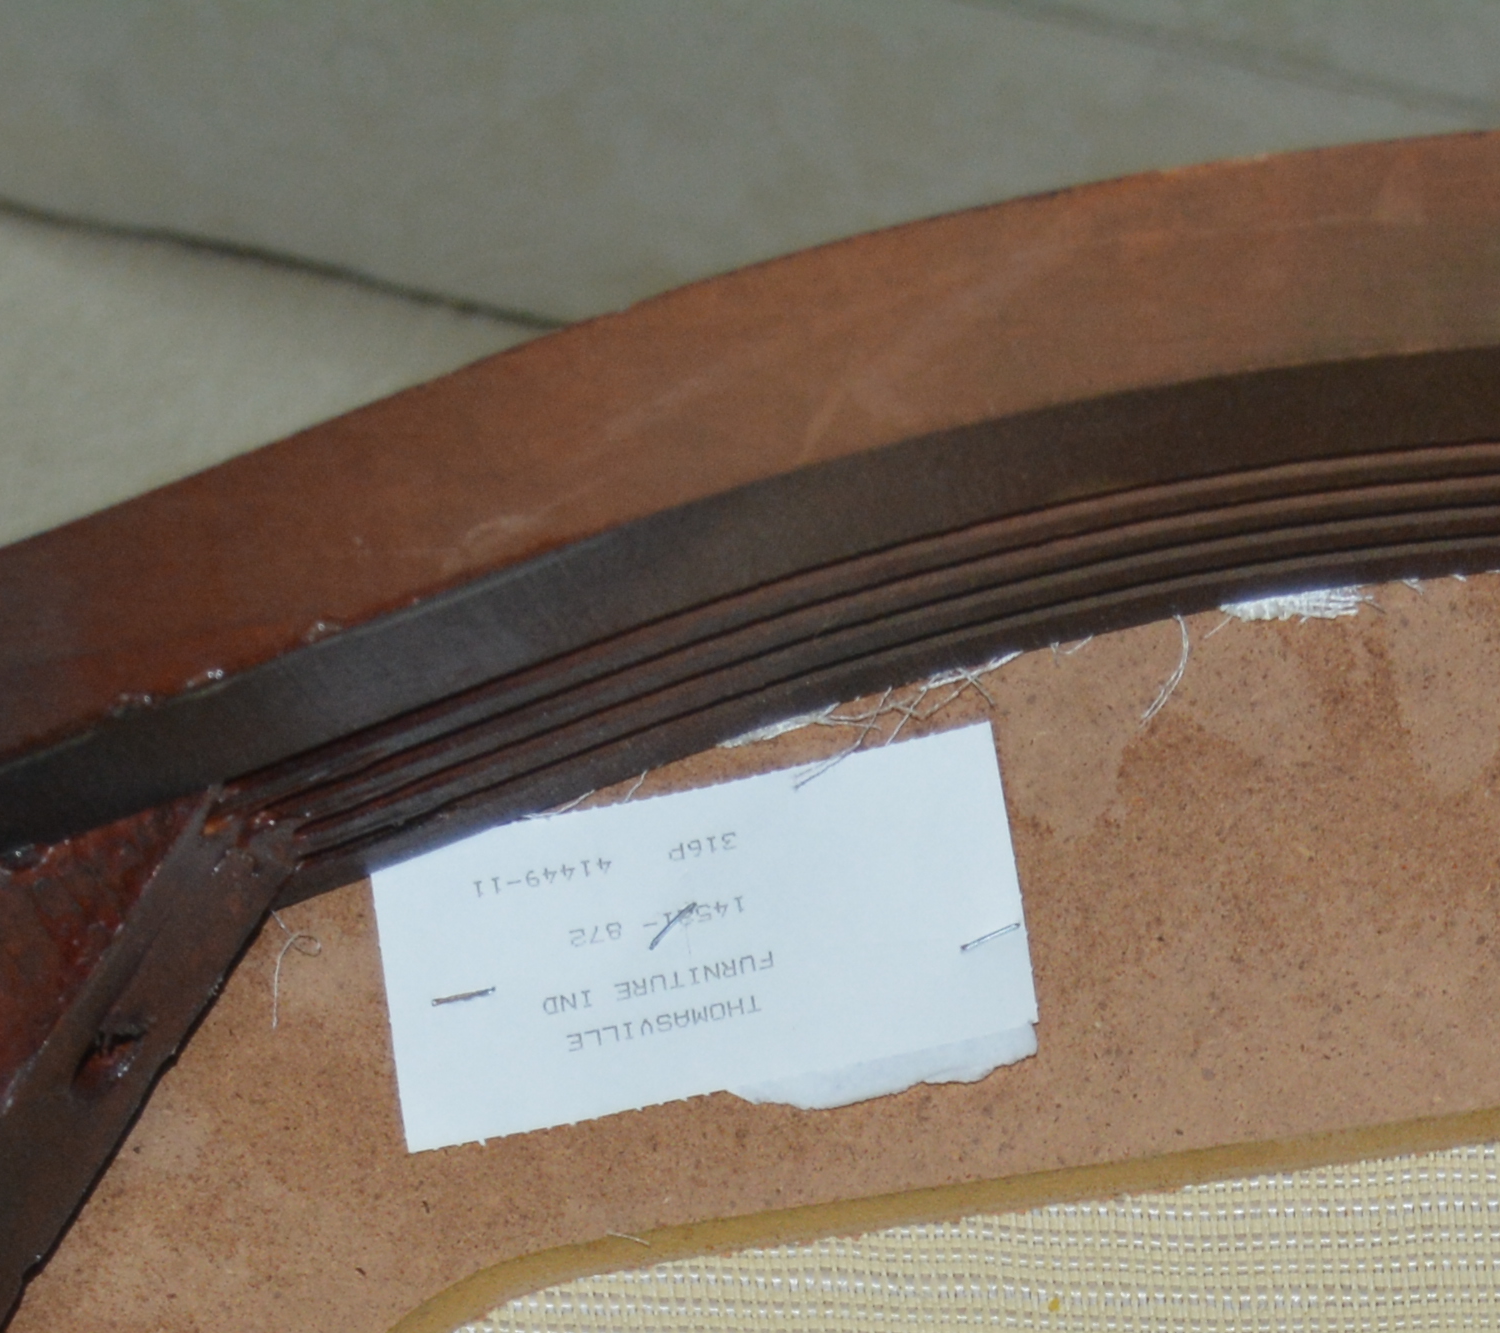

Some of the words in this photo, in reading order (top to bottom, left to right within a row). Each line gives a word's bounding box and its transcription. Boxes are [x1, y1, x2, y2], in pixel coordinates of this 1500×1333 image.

[667, 830, 737, 861] 316P
[472, 856, 612, 898] 41449-11
[566, 919, 624, 949] 872
[613, 949, 774, 1000] FURNITURE
[541, 988, 592, 1016] IND
[565, 994, 761, 1052] THOMASVILLE
